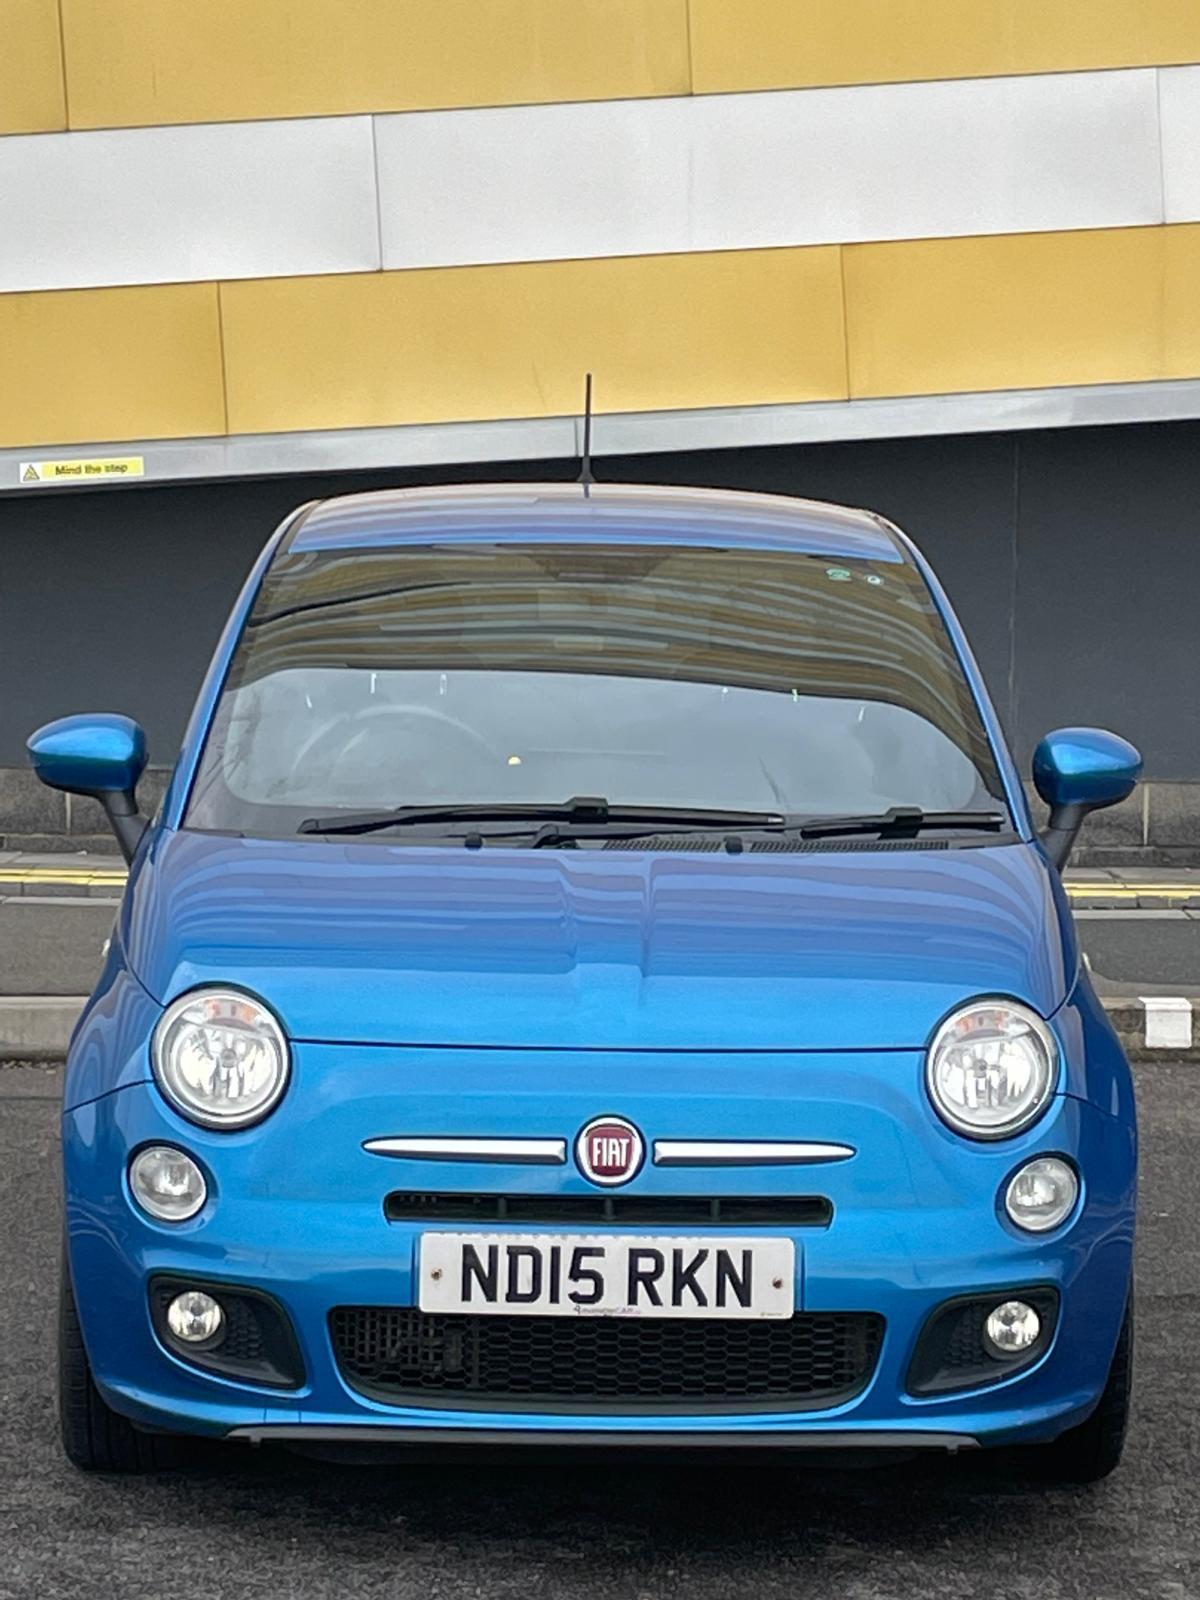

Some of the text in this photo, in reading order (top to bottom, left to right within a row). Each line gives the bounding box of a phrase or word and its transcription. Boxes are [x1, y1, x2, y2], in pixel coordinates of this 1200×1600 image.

[55, 463, 128, 475] Mind the step
[592, 1137, 630, 1167] FIAT
[461, 1243, 753, 1307] ND15 RKN
